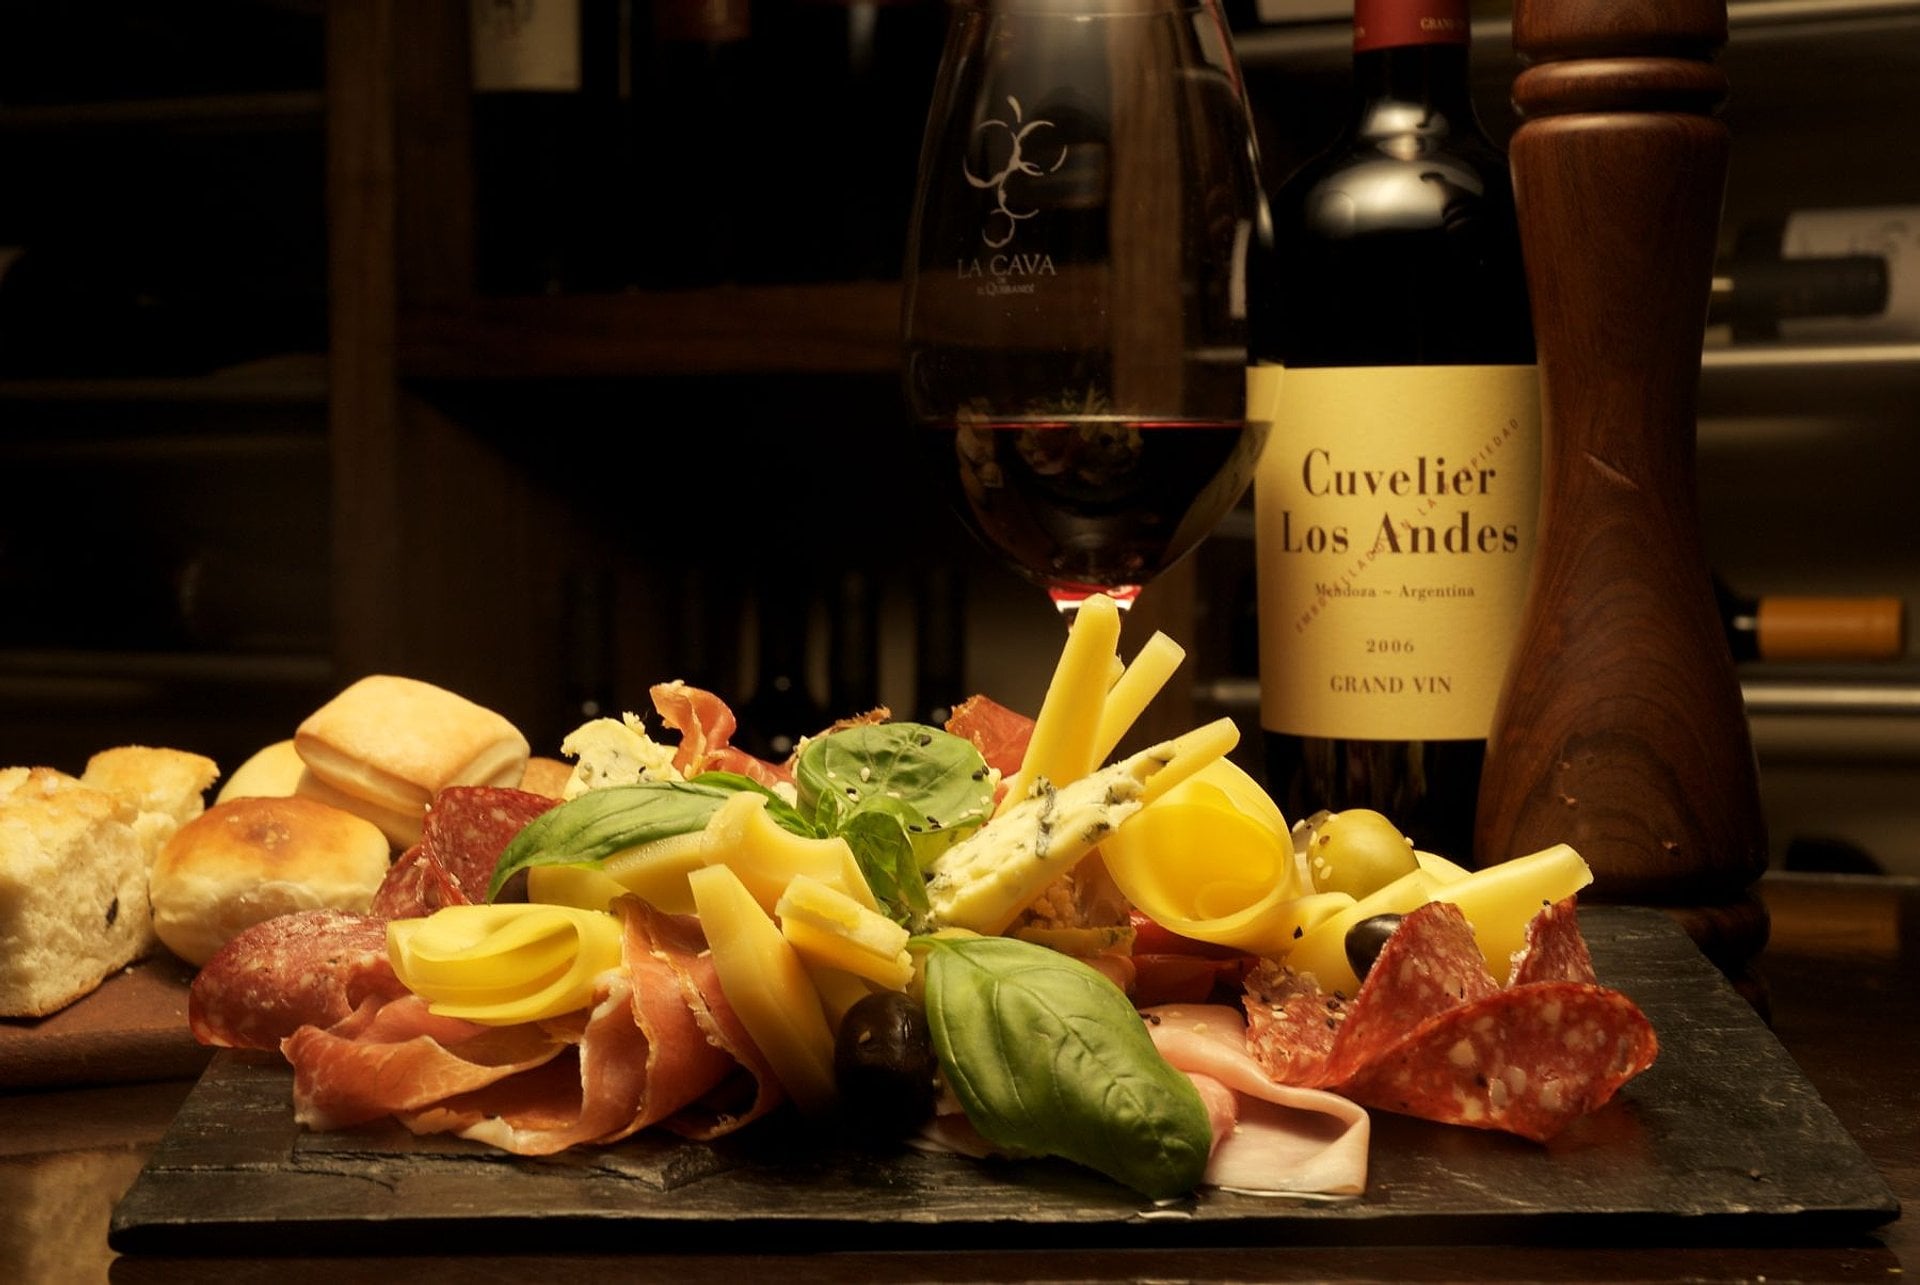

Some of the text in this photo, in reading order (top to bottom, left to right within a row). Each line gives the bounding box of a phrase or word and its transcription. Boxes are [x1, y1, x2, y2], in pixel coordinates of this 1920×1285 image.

[958, 253, 1056, 279] LA CAVA
[1302, 448, 1496, 497] Cuvelier
[1282, 511, 1518, 555] Los Andes
[1315, 583, 1376, 598] Mendoza
[1400, 585, 1475, 602] Argentina
[1366, 639, 1414, 653] 2006
[1330, 675, 1452, 694] GRAND VIN
